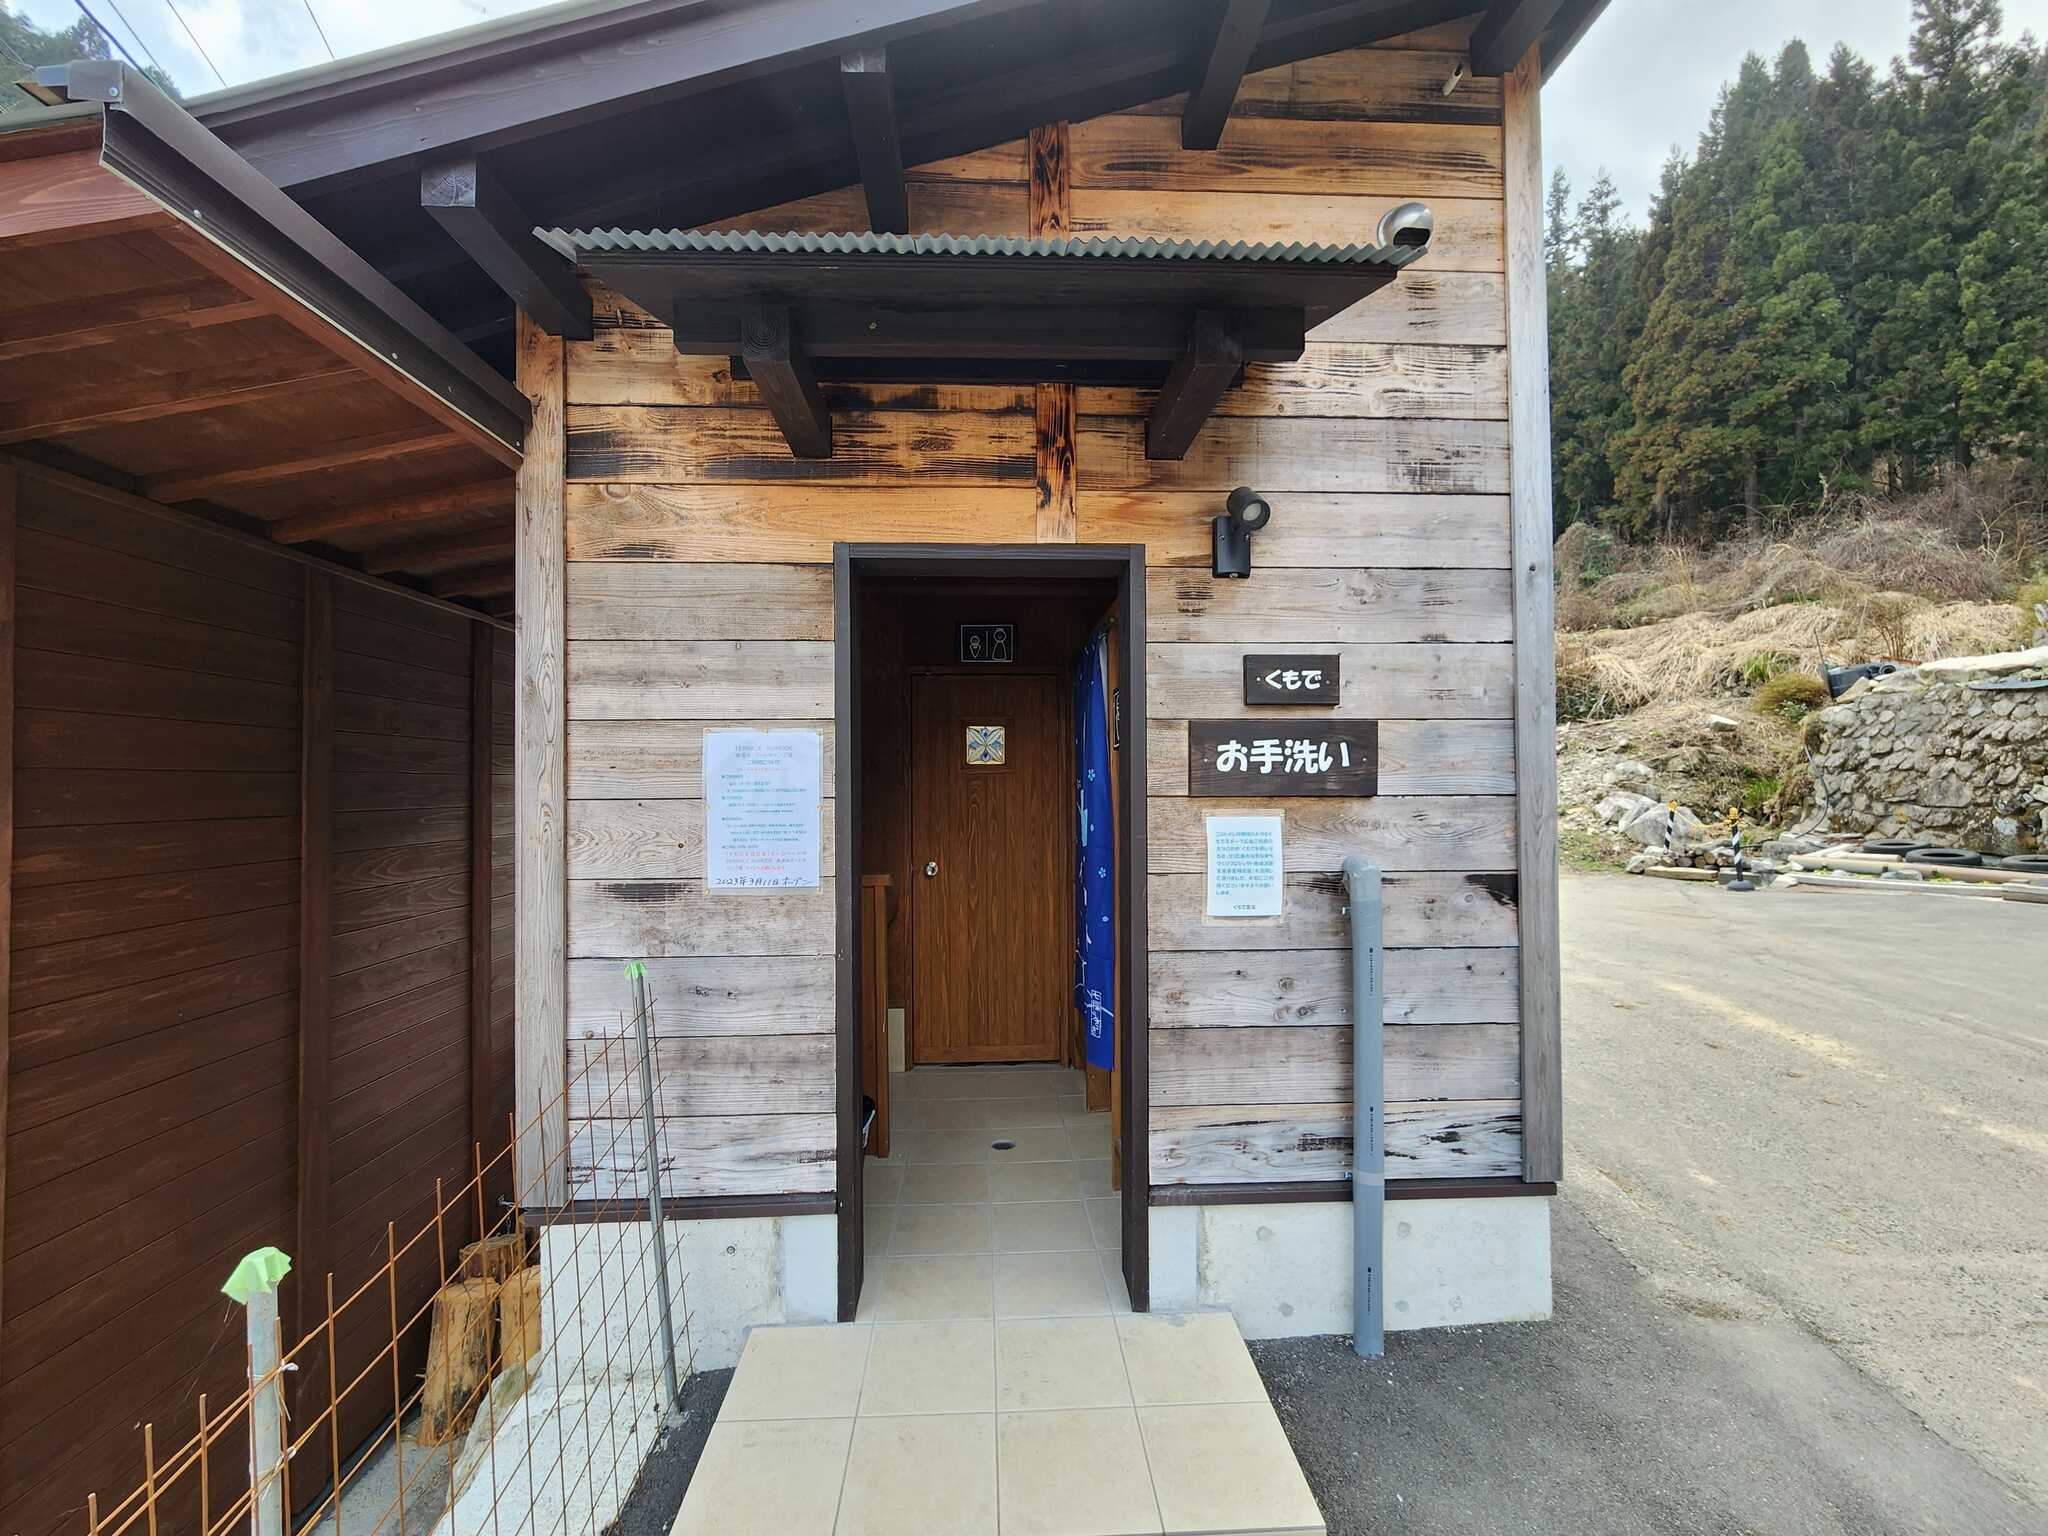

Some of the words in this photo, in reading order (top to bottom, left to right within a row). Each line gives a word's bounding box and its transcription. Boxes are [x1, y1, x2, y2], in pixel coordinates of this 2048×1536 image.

[1264, 669, 1322, 690] くもで
[1216, 738, 1350, 774] お手洗い
